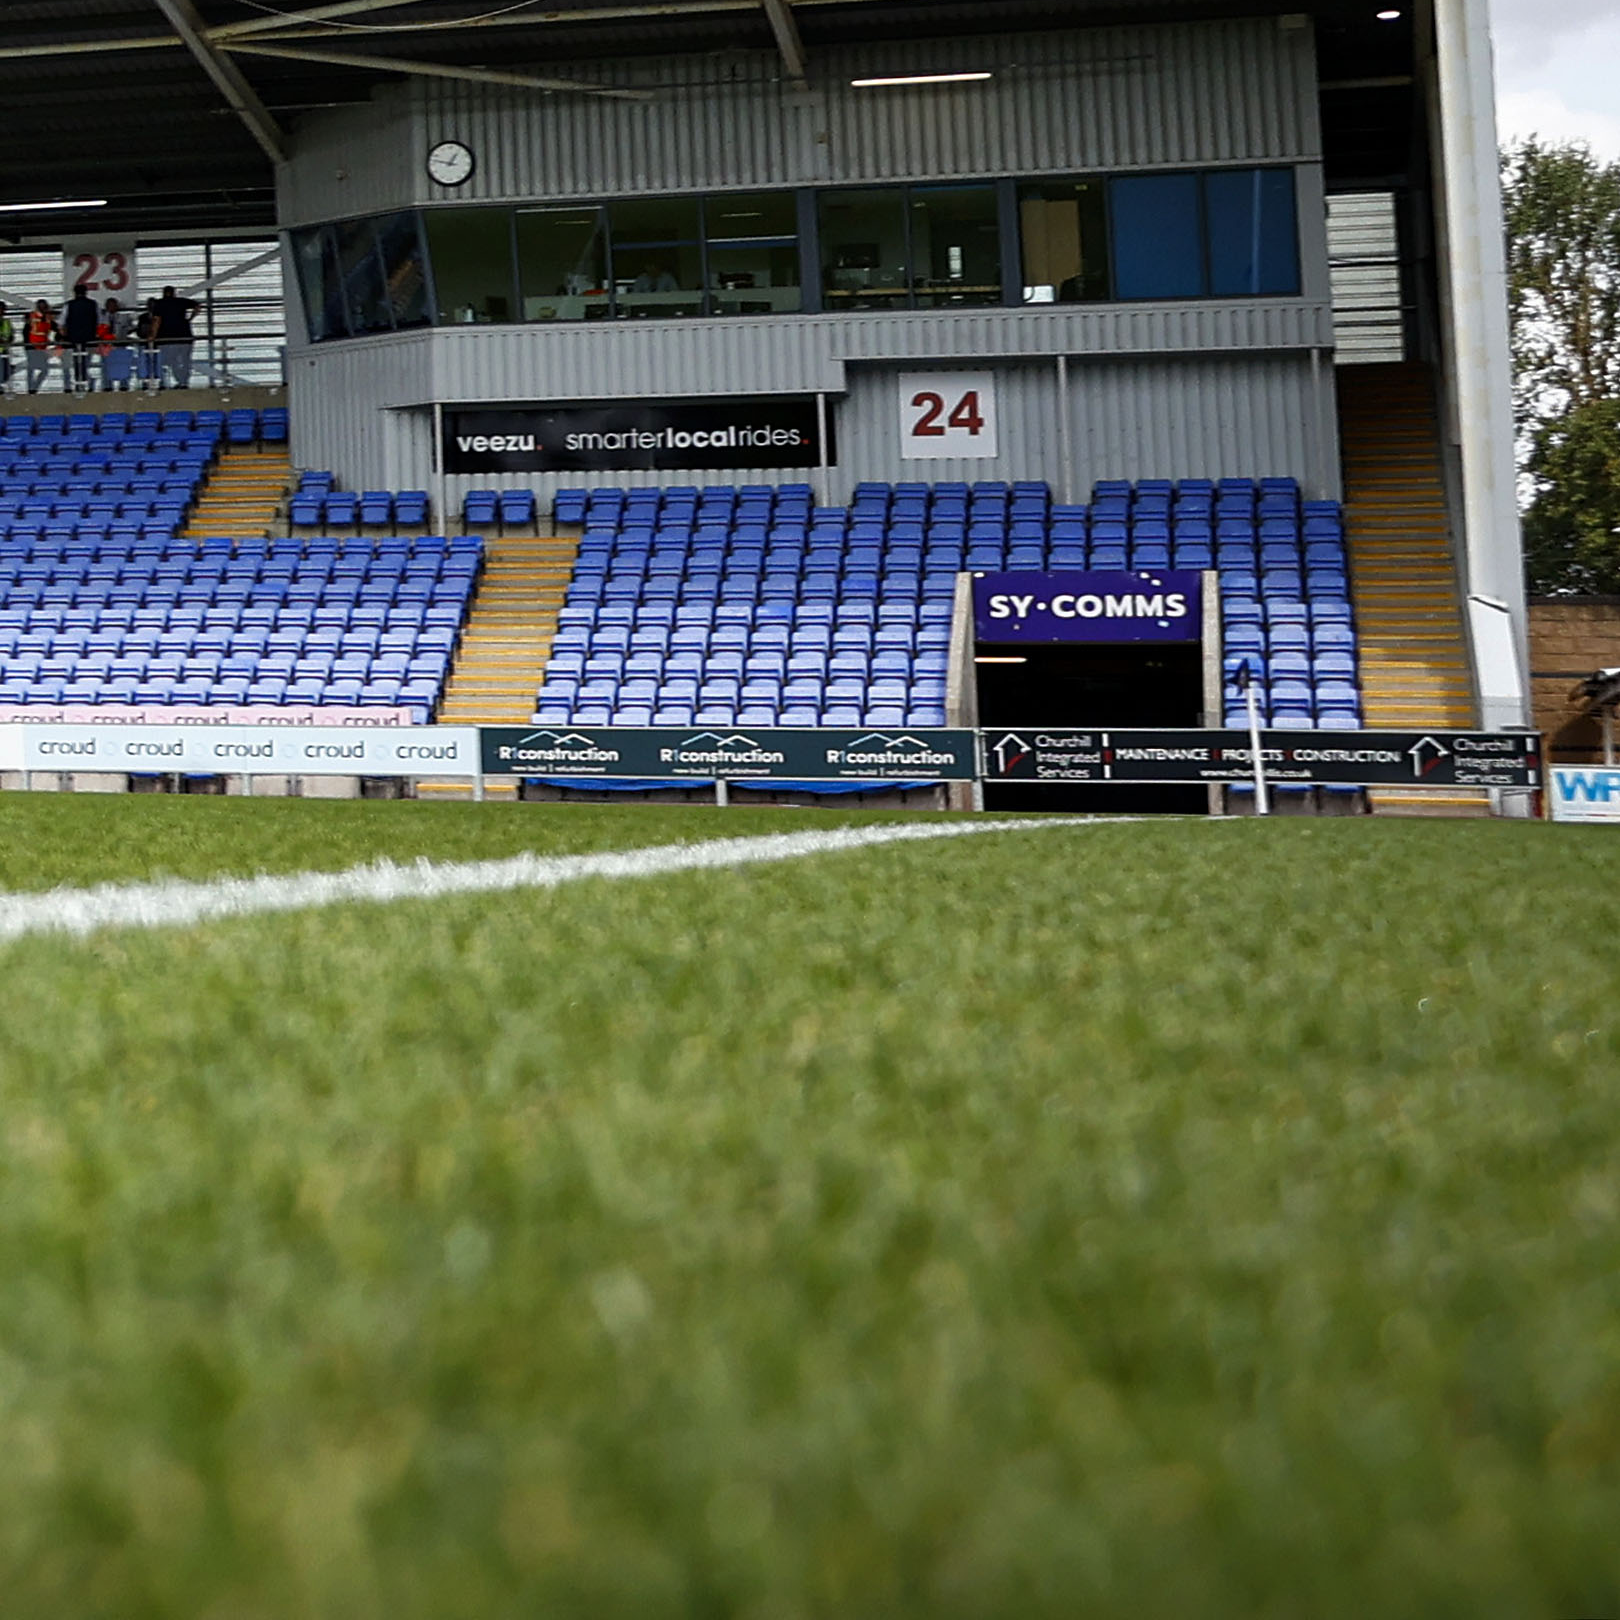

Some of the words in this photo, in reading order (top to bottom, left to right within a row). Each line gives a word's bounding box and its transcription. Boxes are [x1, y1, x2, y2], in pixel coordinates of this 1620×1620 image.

[73, 252, 130, 292] 23
[911, 391, 985, 437] 24
[456, 433, 543, 453] veezu.
[38, 737, 96, 755] croud
[125, 738, 184, 757] croud
[213, 739, 274, 758] croud
[304, 740, 365, 759] croud
[395, 741, 458, 760] croud
[1035, 734, 1093, 748] Churchill
[1452, 737, 1515, 752] Churchill
[1036, 751, 1101, 766] Integrated
[1115, 748, 1209, 761] MAINTENANCE
[1221, 749, 1284, 764] PROJCTS
[1293, 749, 1402, 763] CONSTRUCTION
[1454, 755, 1525, 770] Integrated
[1036, 766, 1090, 778] Services
[1454, 770, 1513, 784] Services
